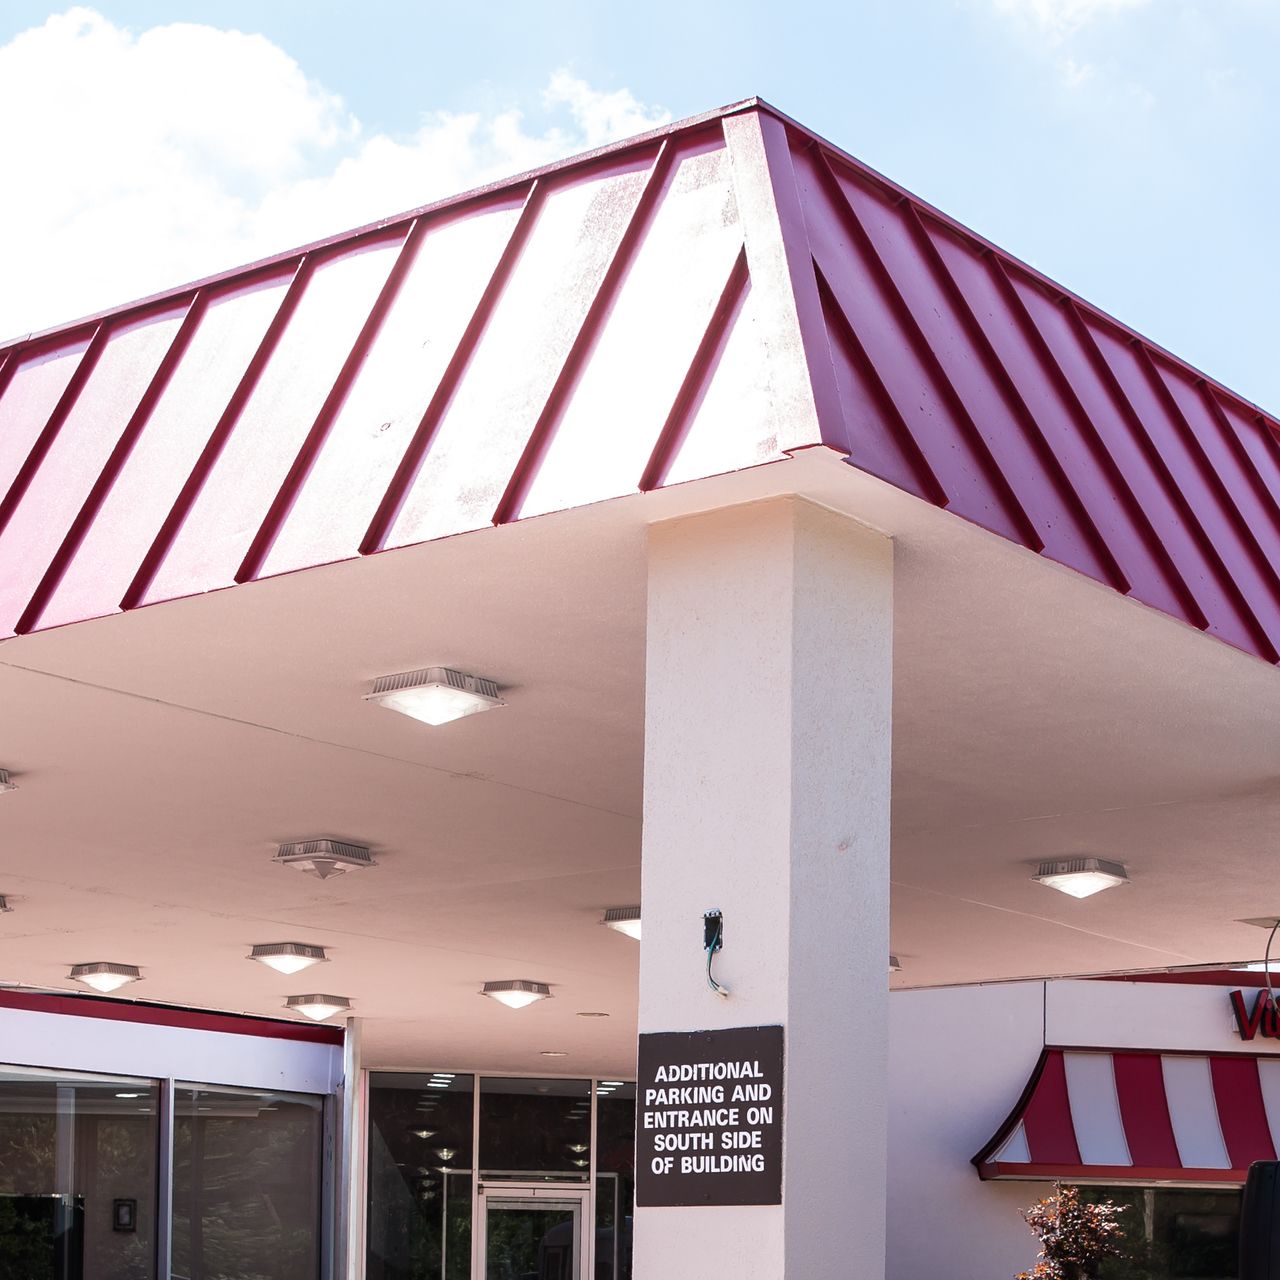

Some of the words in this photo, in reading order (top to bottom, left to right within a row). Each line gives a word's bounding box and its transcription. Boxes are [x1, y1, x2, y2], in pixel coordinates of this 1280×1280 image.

[654, 1060, 764, 1083] ADDITIONAL
[645, 1085, 725, 1106] PARKING
[731, 1083, 772, 1102] AND
[643, 1108, 740, 1129] ENTRANCE
[746, 1106, 773, 1125] ON
[654, 1132, 714, 1152] SOUTH
[721, 1130, 762, 1149] SIDE
[651, 1156, 674, 1175] OF
[681, 1154, 765, 1174] BUILDING
